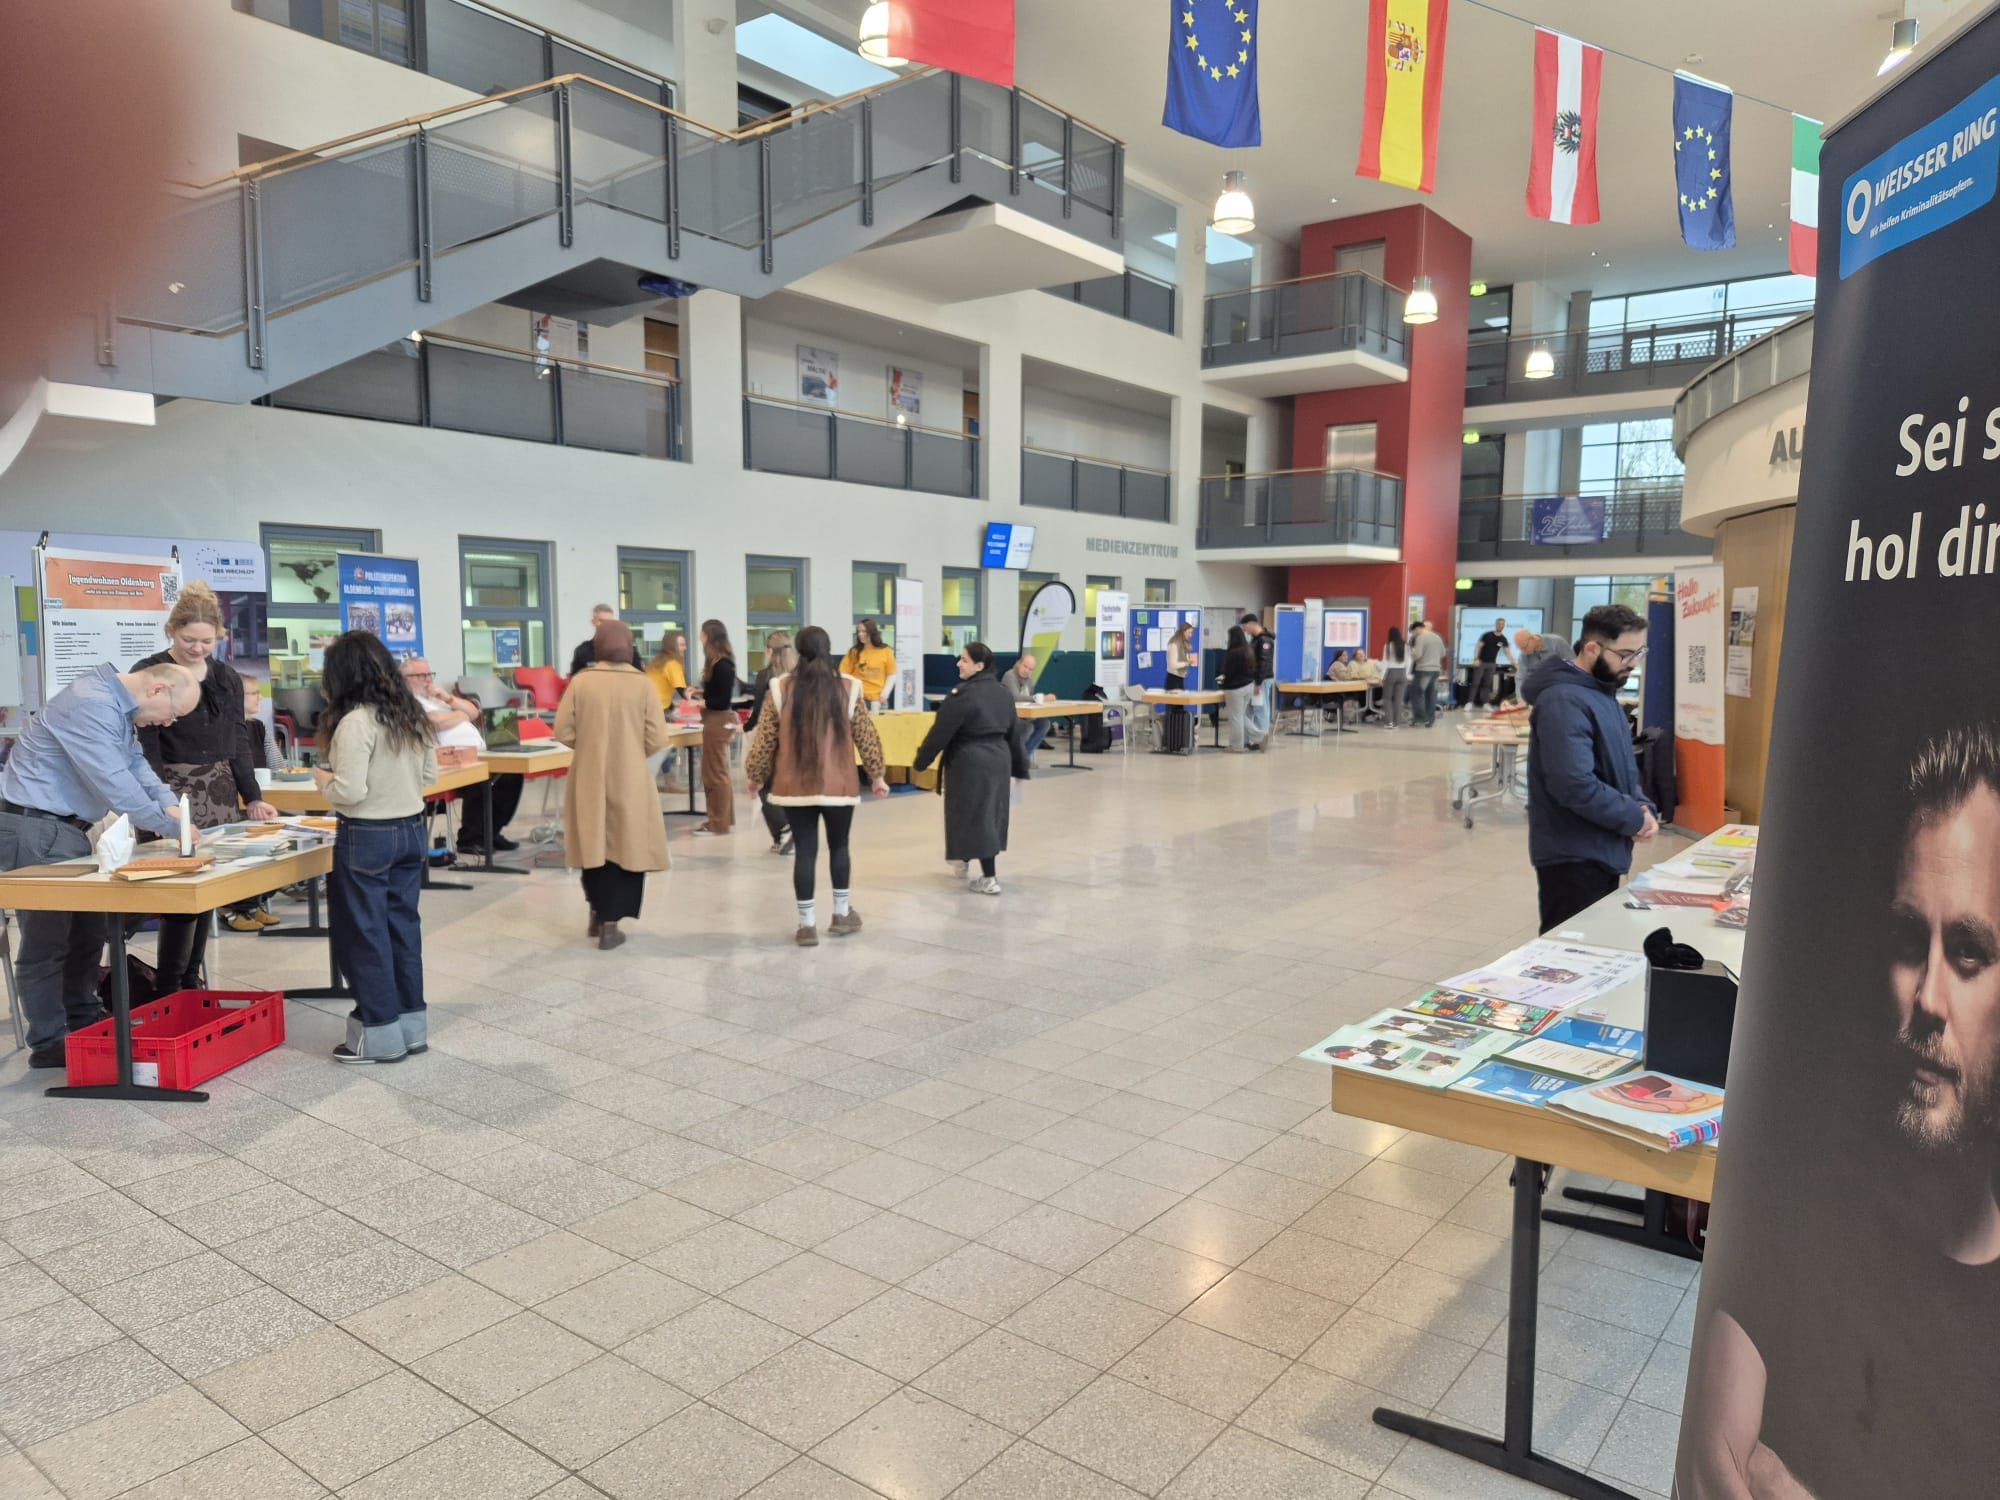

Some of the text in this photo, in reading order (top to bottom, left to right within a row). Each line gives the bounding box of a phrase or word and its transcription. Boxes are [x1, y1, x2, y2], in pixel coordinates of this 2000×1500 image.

[1874, 107, 1998, 207] WEISSER RING
[1879, 214, 1900, 233] helfen
[1900, 177, 1975, 222] Kriminalitätsopfern.
[1896, 396, 1969, 477] Sei
[1086, 536, 1178, 559] MEDIENZENTRUM
[1845, 512, 1922, 582] hol
[68, 573, 155, 588] Jugendwohnen Oldenburg
